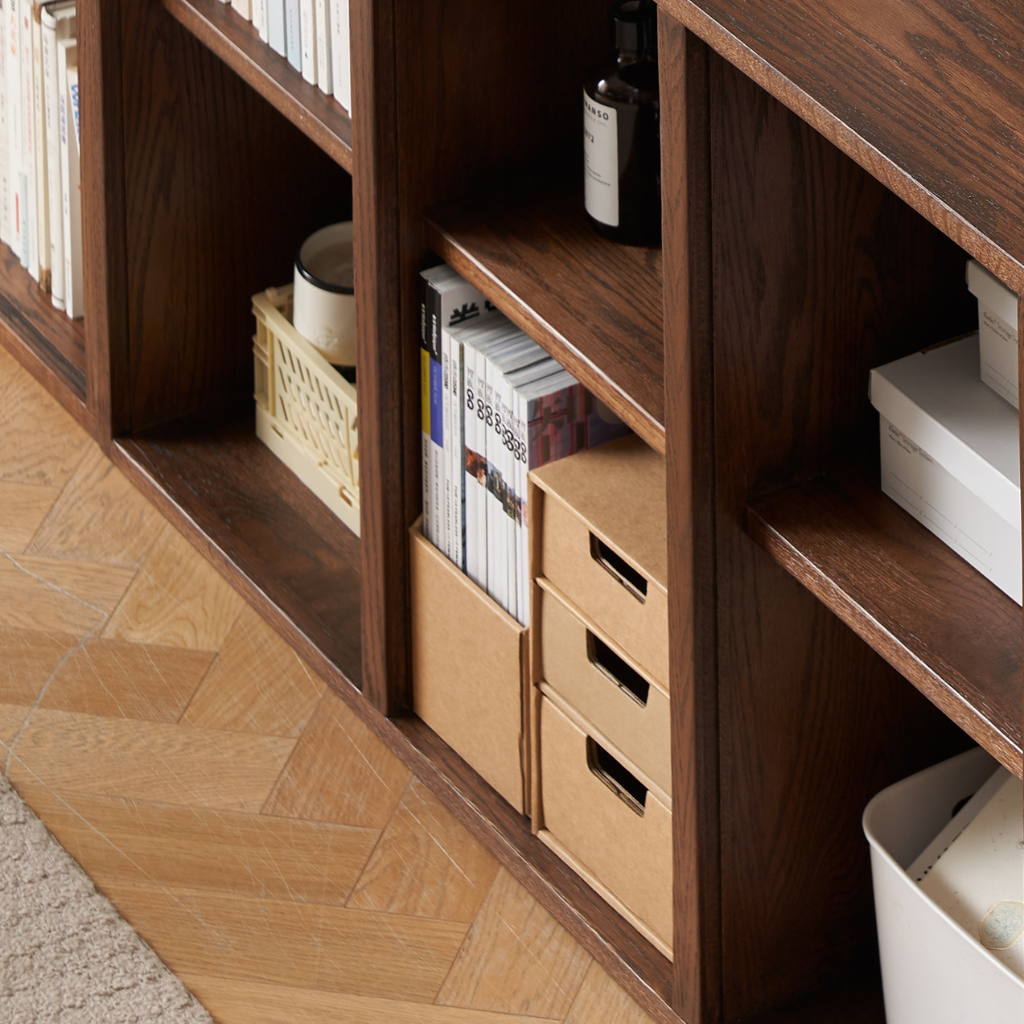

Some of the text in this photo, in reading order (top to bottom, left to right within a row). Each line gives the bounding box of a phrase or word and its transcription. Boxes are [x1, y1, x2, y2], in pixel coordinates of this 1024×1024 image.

[467, 388, 474, 411] GQ
[477, 398, 484, 420] GQ
[485, 405, 493, 427] GQ
[494, 413, 501, 434] GQ
